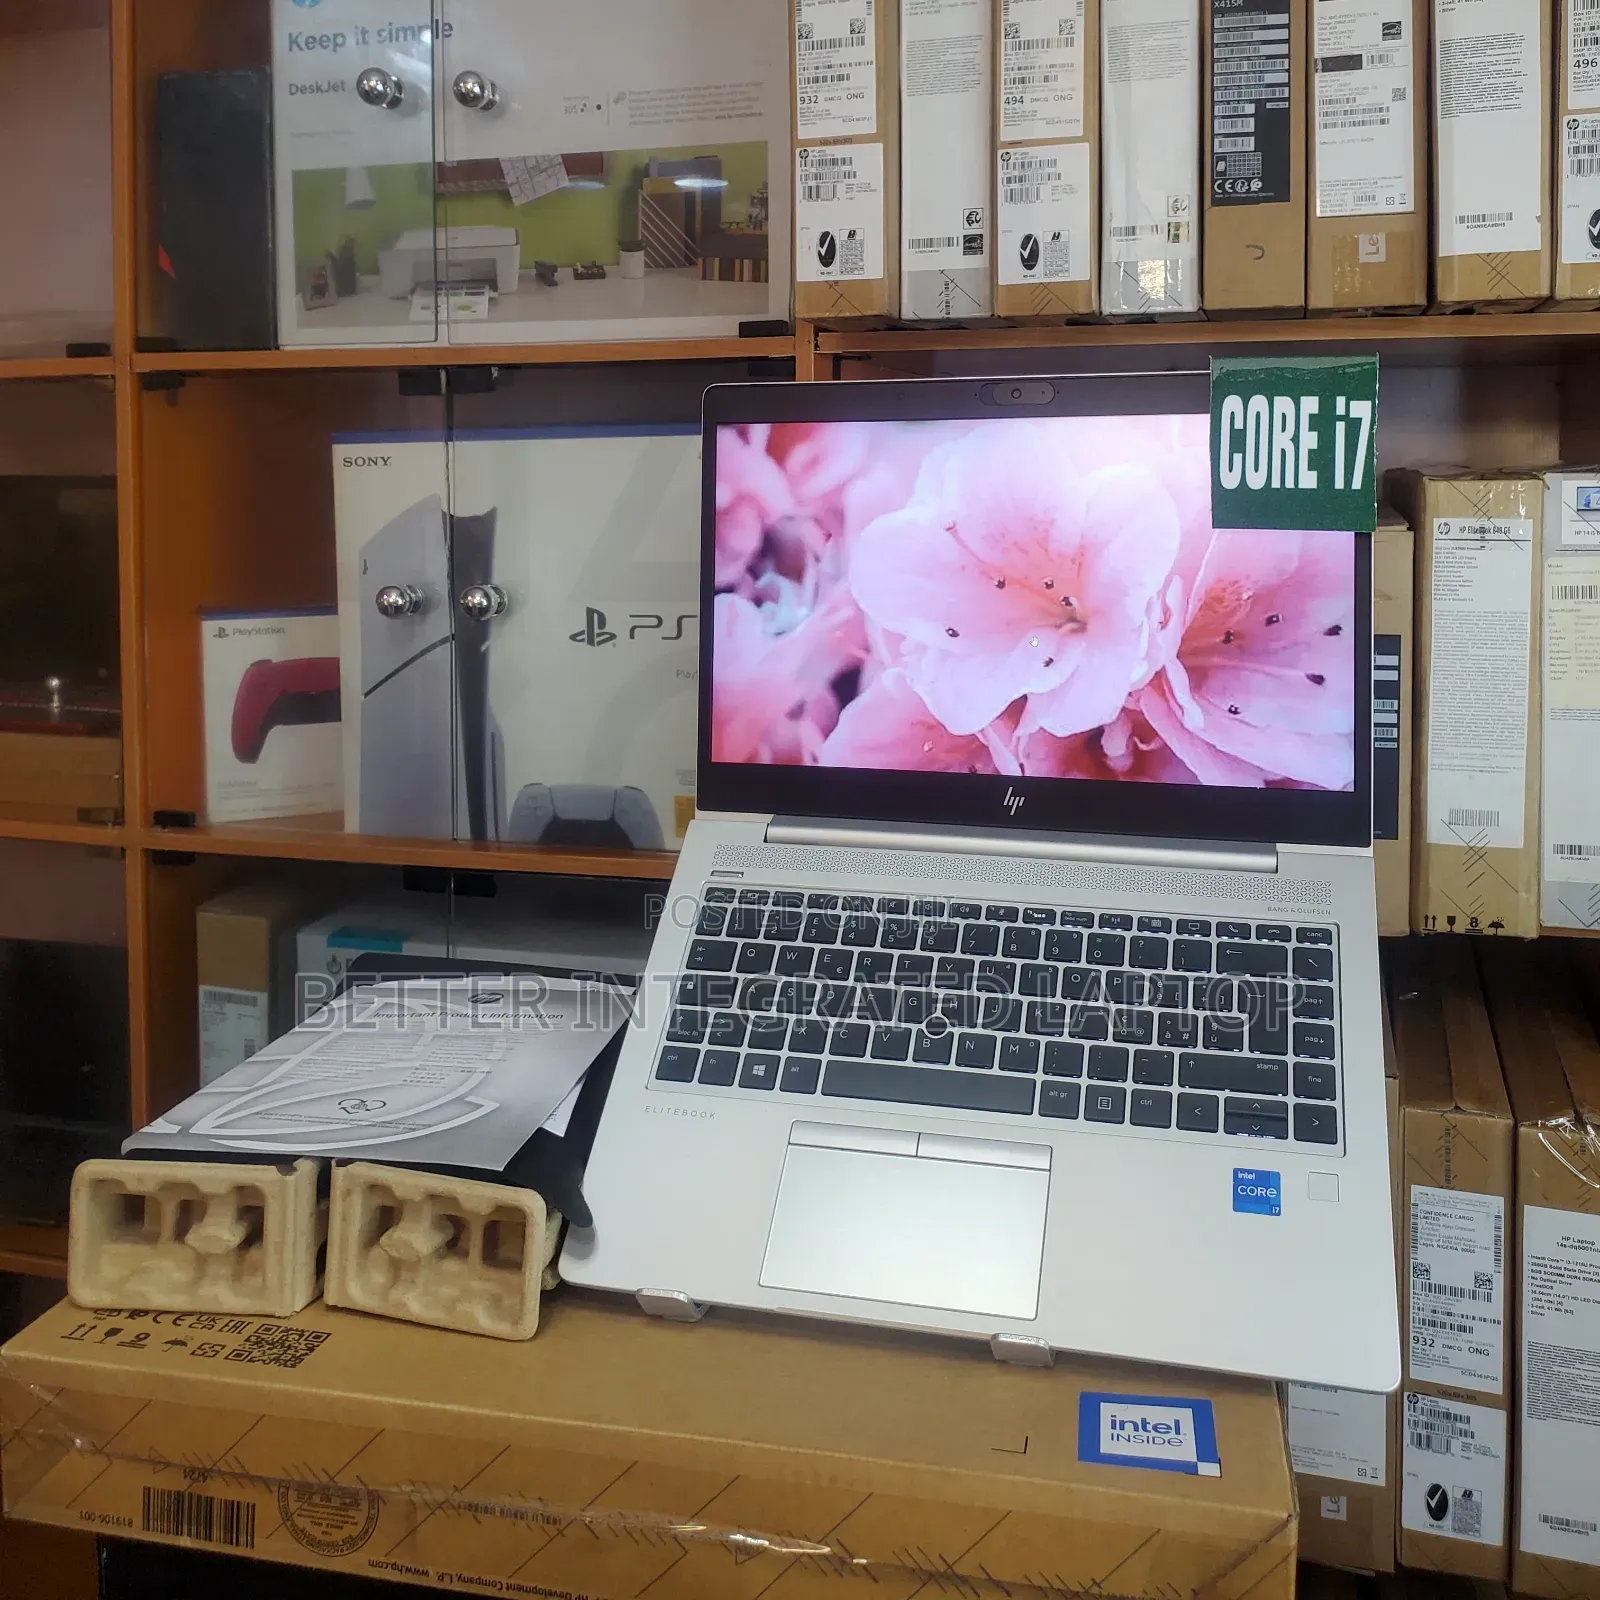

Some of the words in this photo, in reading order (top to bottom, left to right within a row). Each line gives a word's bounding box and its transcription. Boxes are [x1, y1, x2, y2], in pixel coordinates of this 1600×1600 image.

[287, 32, 347, 52] Keep
[354, 24, 369, 46] it
[1573, 58, 1598, 69] 496
[288, 80, 346, 96] DeskJet
[799, 95, 819, 105] 932
[846, 92, 865, 100] ONG
[1004, 96, 1025, 105] 494
[1053, 94, 1073, 102] ONG
[1220, 394, 1320, 490] CORE
[1334, 396, 1372, 490] i7
[342, 456, 392, 468] SONY
[1459, 526, 1467, 534] HP
[1468, 526, 1492, 535] Eliteok
[233, 626, 285, 636] PlayStation
[1003, 787, 1025, 816] hp
[1297, 907, 1331, 915] OLUFSEN
[1470, 917, 1479, 928] 8
[489, 1012, 564, 1020] Information
[1256, 1063, 1279, 1071] stamp
[644, 1105, 716, 1120] ELITEBOOK
[1238, 1171, 1256, 1180] intel
[1238, 1185, 1277, 1198] CORE
[1420, 1209, 1453, 1219] CONFIDENCE
[1455, 1213, 1474, 1222] CARGO
[1572, 1237, 1596, 1246] Laptop
[1413, 1335, 1435, 1348] 932
[1442, 1344, 1463, 1352] DMCQ
[1468, 1346, 1490, 1357] ONG
[1110, 1415, 1181, 1436] intel
[1111, 1433, 1184, 1447] INSIDE
[80, 1510, 134, 1528] 819106-001
[368, 1558, 431, 1578] www.hp.com
[436, 1571, 453, 1584] L.P.
[456, 1573, 504, 1590] Company,
